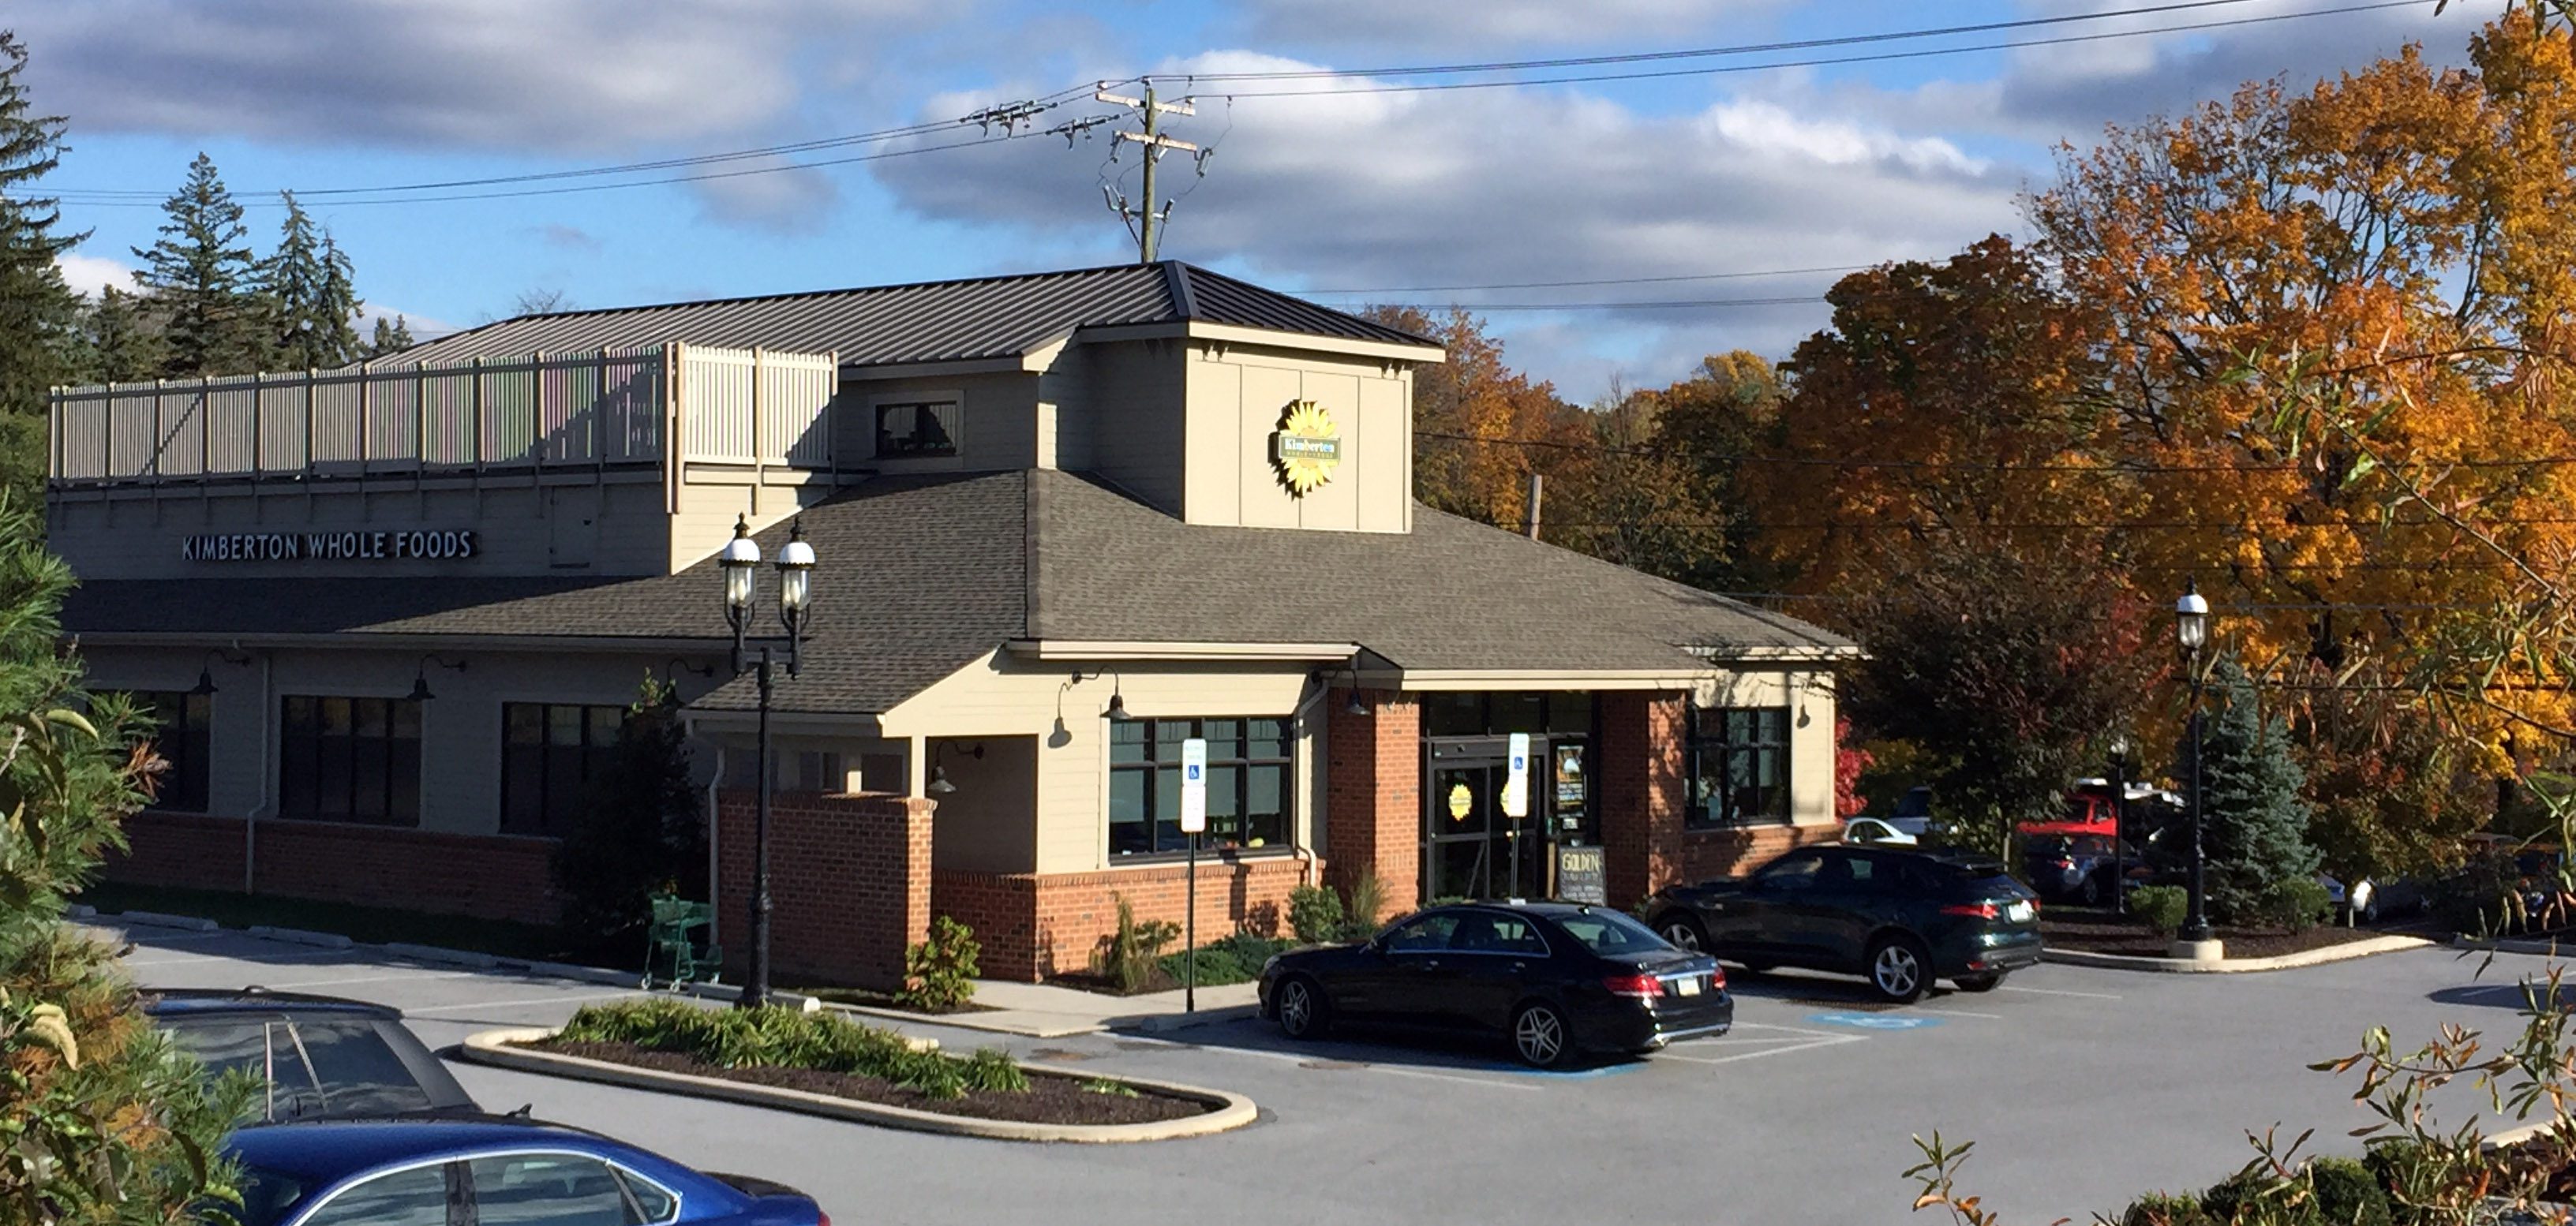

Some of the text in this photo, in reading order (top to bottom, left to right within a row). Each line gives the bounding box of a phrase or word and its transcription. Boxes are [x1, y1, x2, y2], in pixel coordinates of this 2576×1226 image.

[1284, 438, 1335, 453] Kimberton
[182, 531, 471, 561] KIMBERTON WHOLE FOODS
